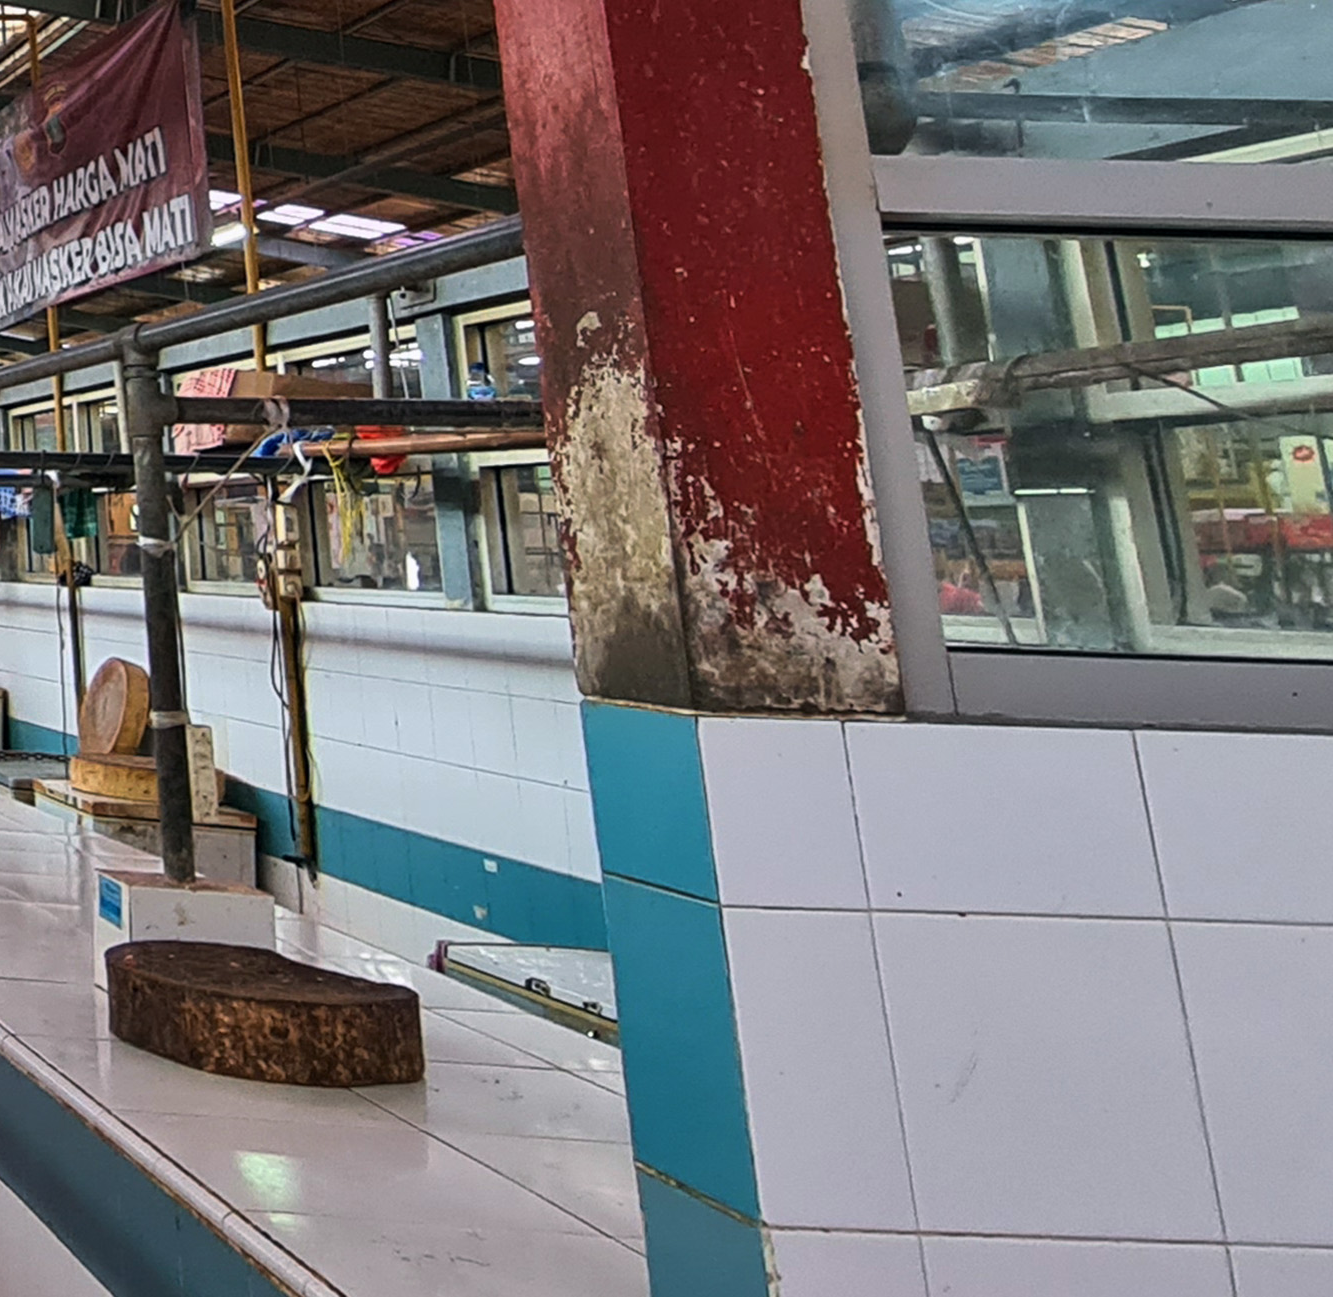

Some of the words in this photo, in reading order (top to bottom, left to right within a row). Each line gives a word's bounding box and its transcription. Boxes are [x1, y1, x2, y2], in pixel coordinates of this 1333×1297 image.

[52, 154, 118, 222] HARGA
[114, 126, 167, 194] MATI
[31, 236, 93, 302] MASKER
[94, 218, 143, 278] BISA
[142, 193, 194, 260] MATI
